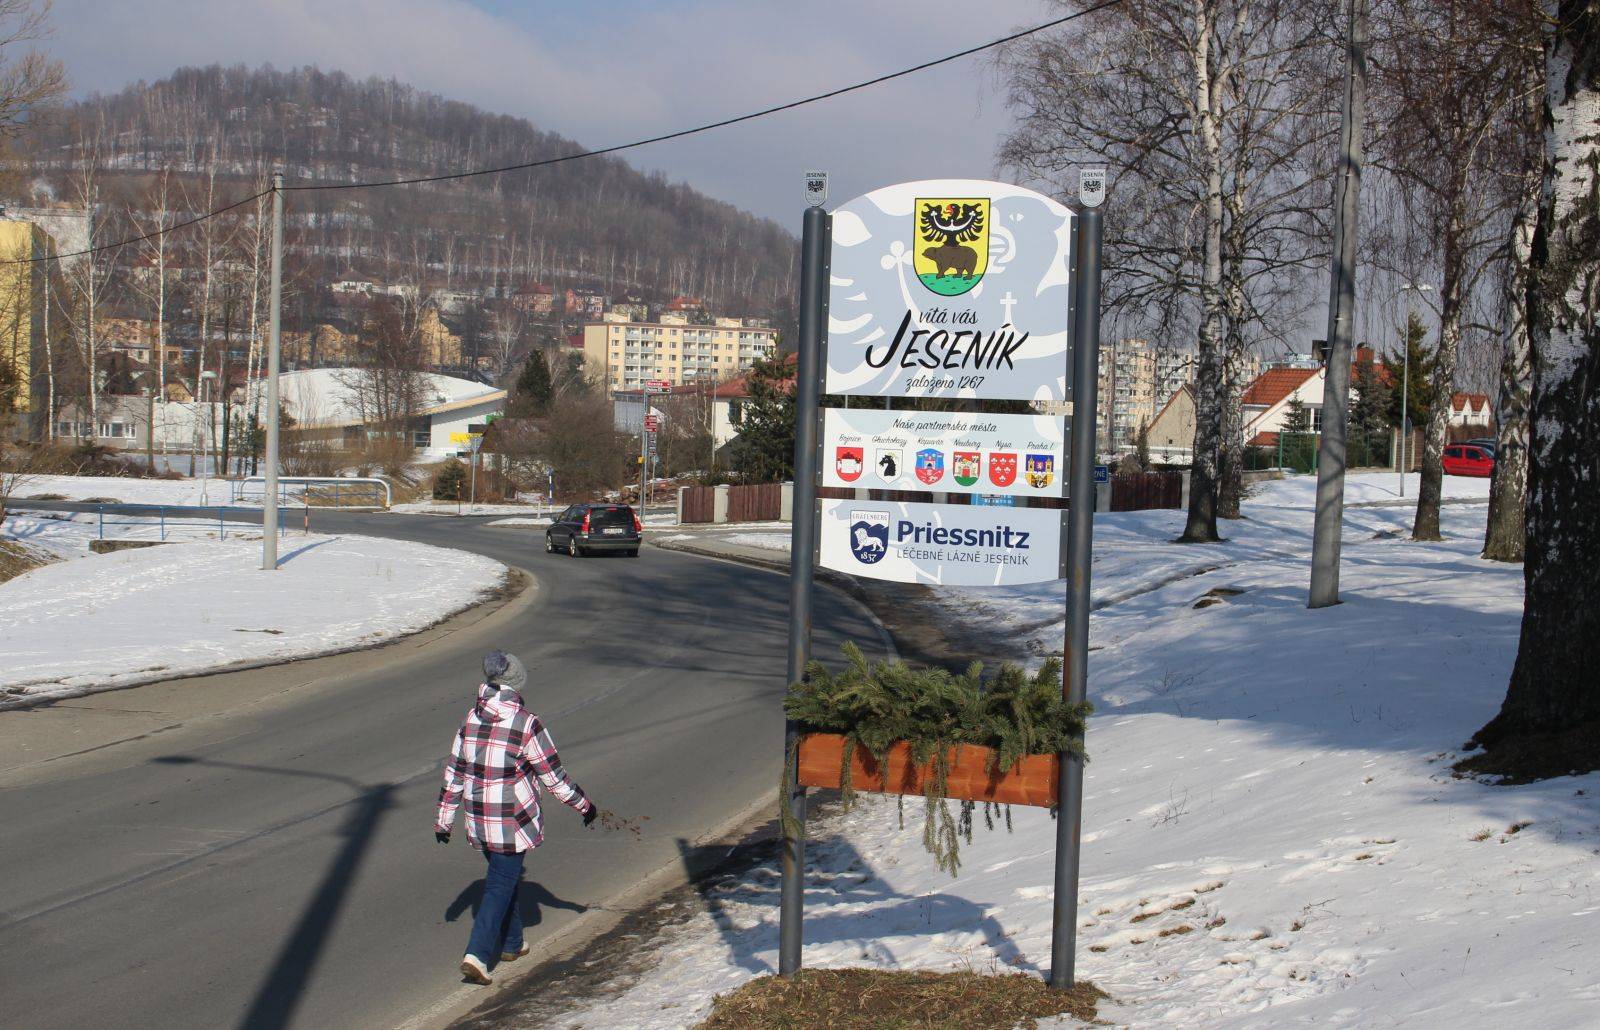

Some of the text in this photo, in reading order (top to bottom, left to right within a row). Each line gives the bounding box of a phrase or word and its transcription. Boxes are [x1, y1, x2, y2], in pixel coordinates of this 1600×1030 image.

[919, 307, 978, 325] vítá vás
[865, 308, 1030, 371] JESENÍK
[905, 374, 985, 394] založeno 1267
[893, 418, 997, 432] Naše partnerská města
[897, 520, 1030, 549] Priessnitz
[896, 546, 1029, 566] LÉČEBNÉ LÁZNĚ JESENÍK
